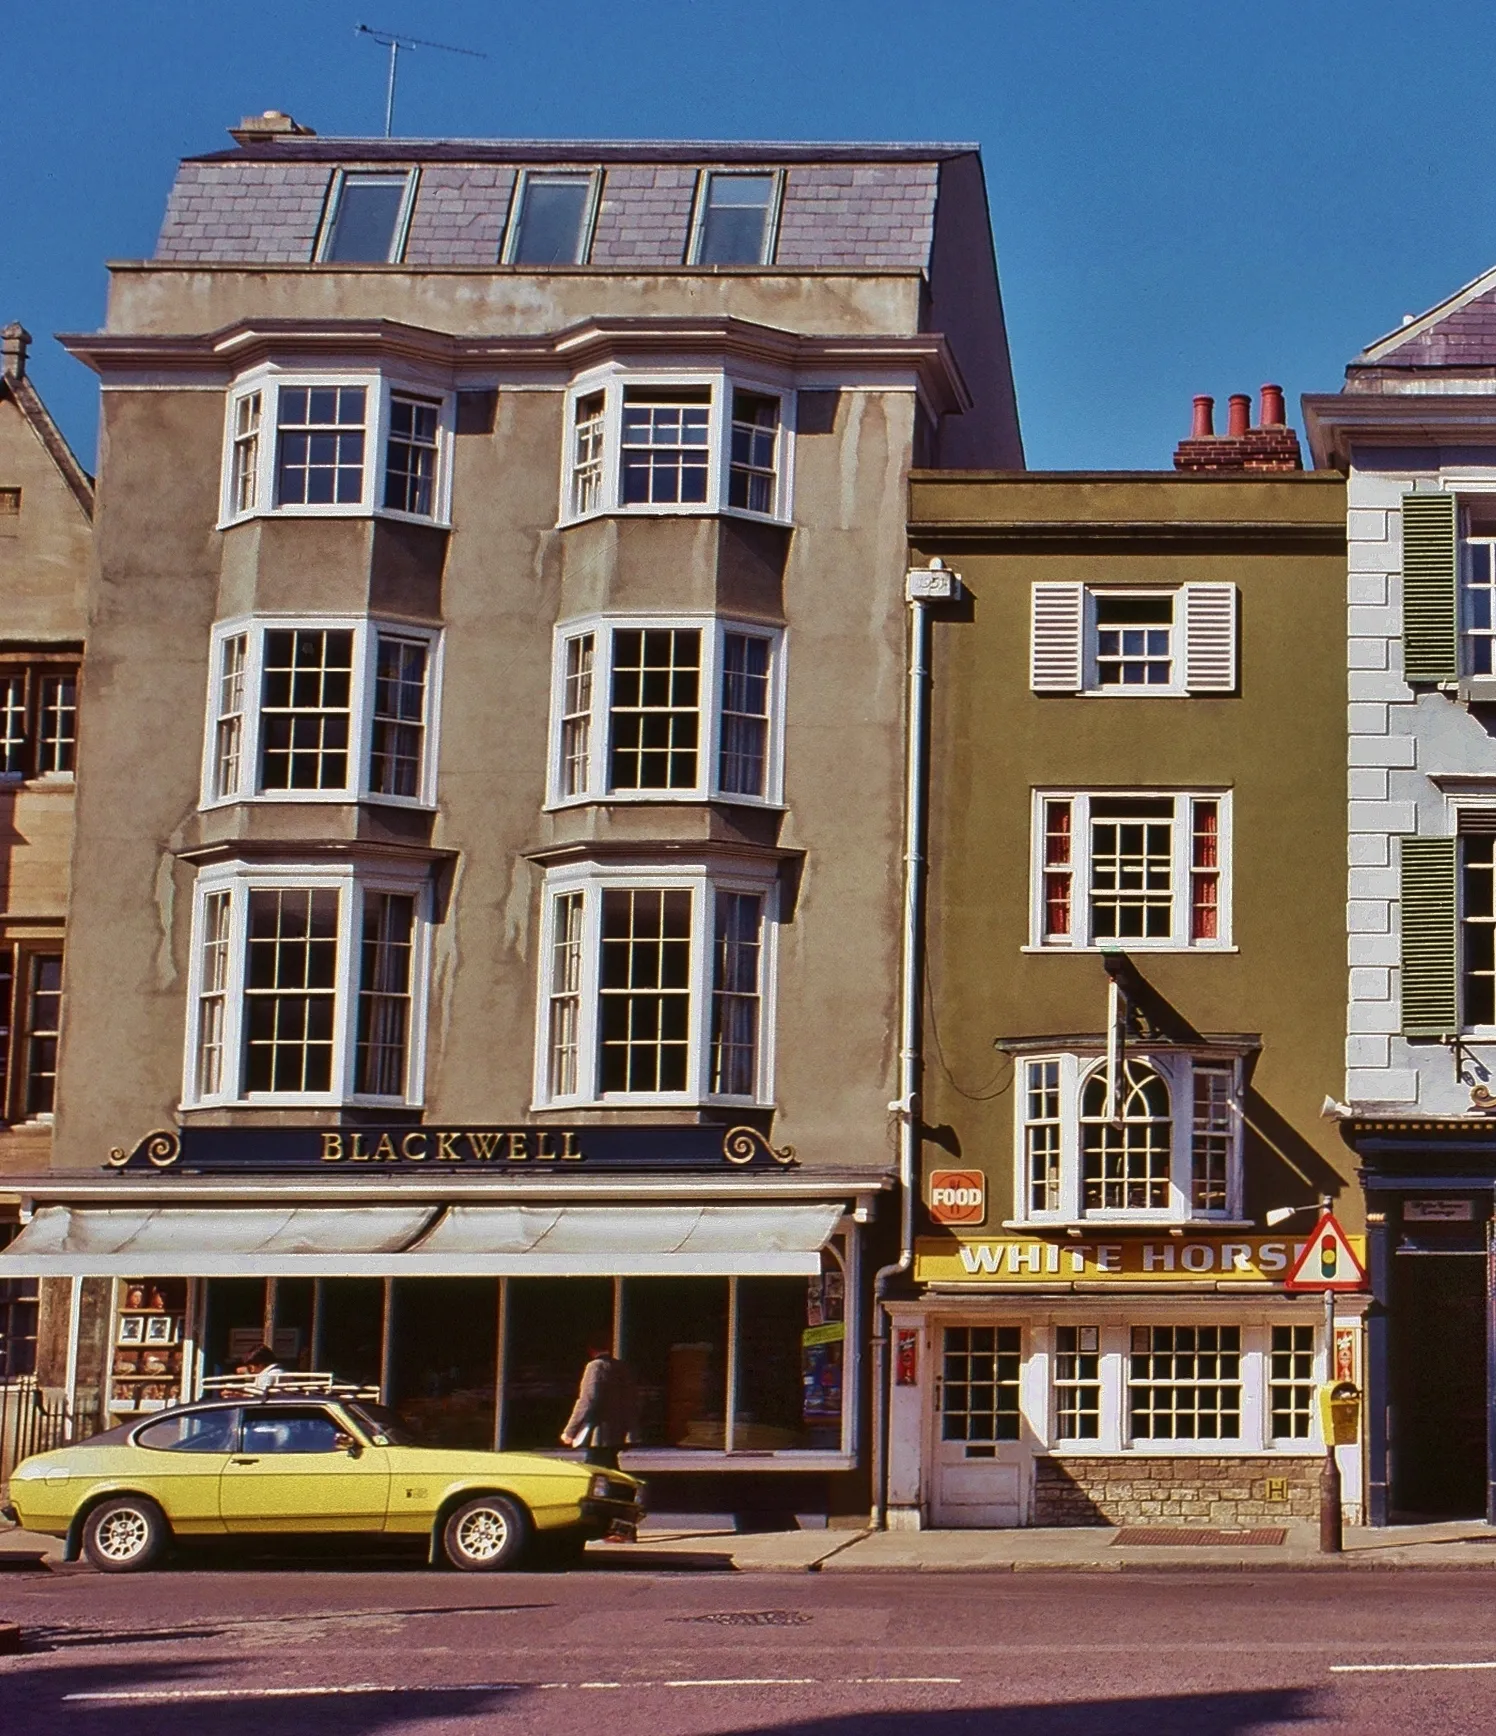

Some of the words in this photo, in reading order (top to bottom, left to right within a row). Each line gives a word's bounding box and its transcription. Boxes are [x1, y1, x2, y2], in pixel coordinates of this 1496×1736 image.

[321, 1132, 582, 1161] BLACKWELL
[932, 1188, 982, 1206] FOOD
[959, 1243, 1121, 1273] WHITE
[1143, 1242, 1308, 1273] HORS
